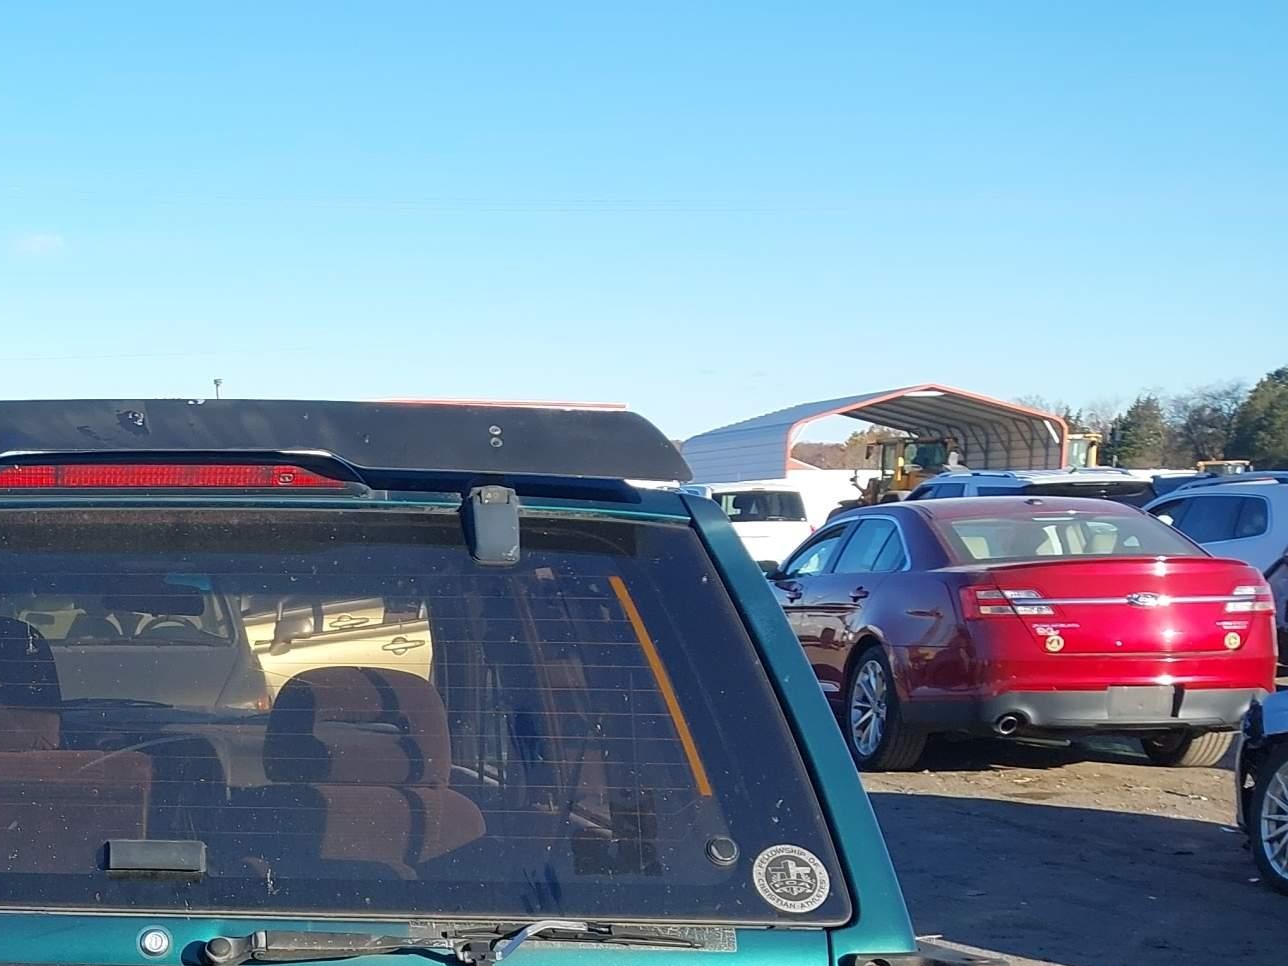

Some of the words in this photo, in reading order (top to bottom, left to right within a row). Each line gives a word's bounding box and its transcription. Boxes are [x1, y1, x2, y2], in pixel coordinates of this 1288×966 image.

[759, 847, 806, 869] FELLOWSHIP
[808, 857, 821, 869] OF
[757, 878, 797, 909] CHRISTIAN
[800, 877, 827, 910] ATHLETES
